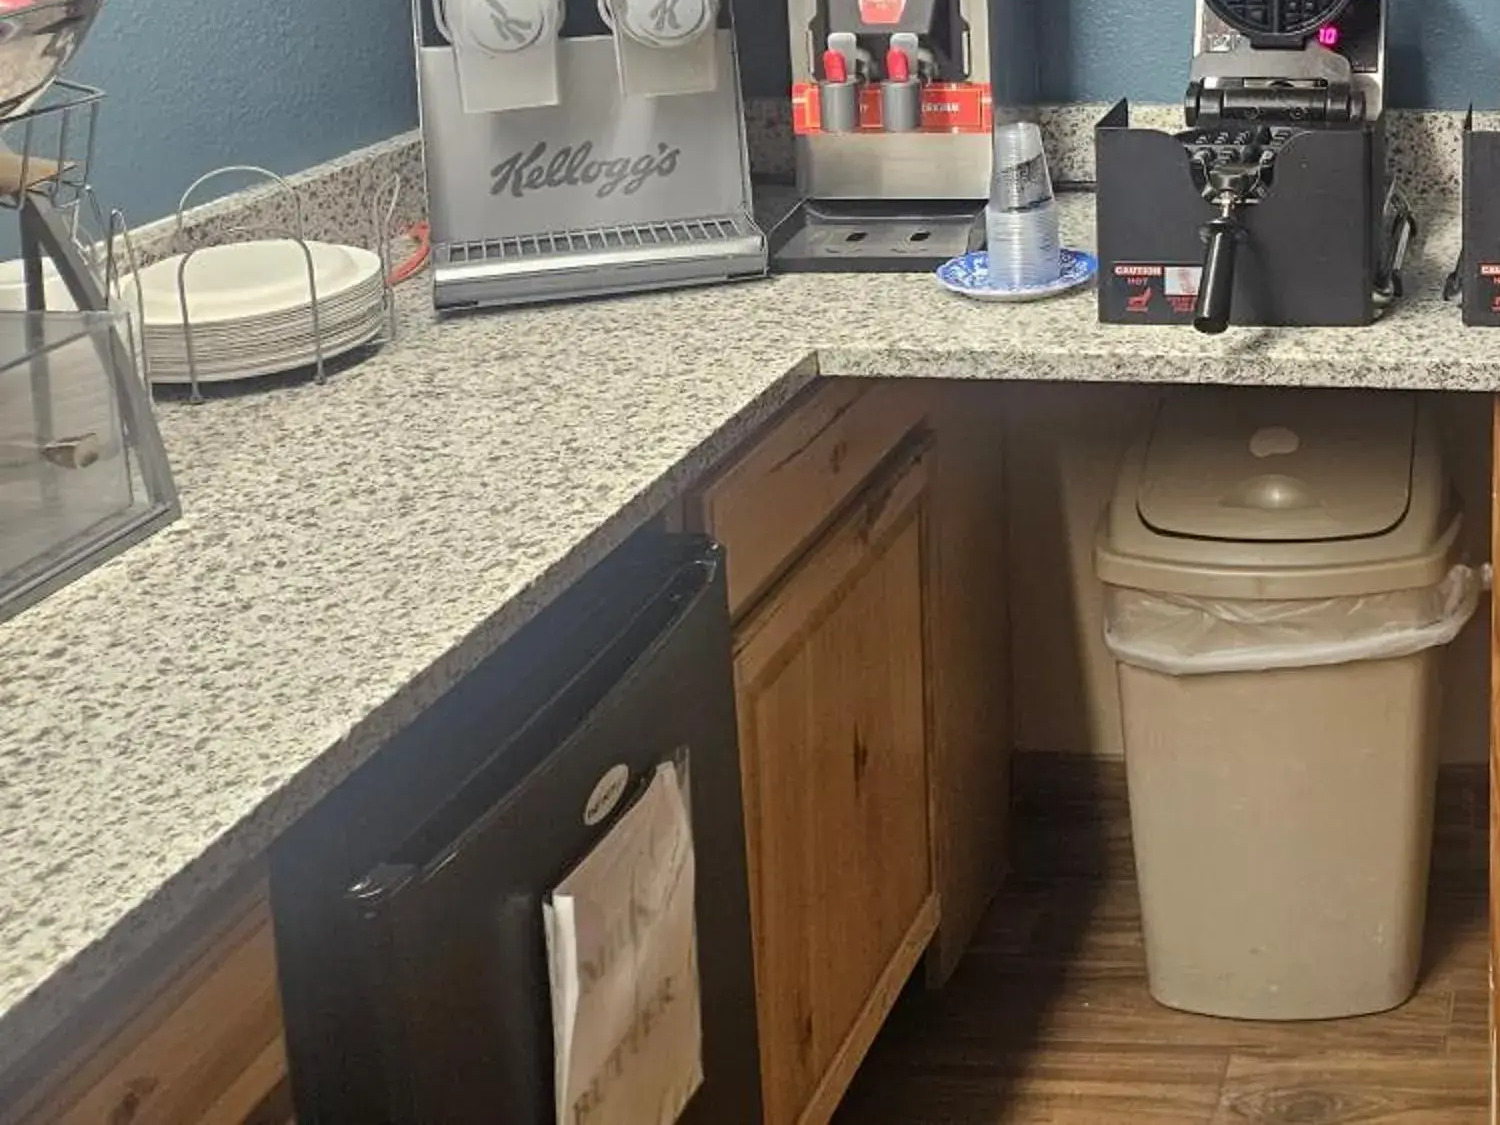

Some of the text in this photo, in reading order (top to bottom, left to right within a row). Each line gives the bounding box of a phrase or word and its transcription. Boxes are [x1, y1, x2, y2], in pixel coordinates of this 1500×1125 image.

[1319, 27, 1338, 44] 10
[488, 140, 681, 198] Kellogg's
[1114, 265, 1162, 276] CAUTION
